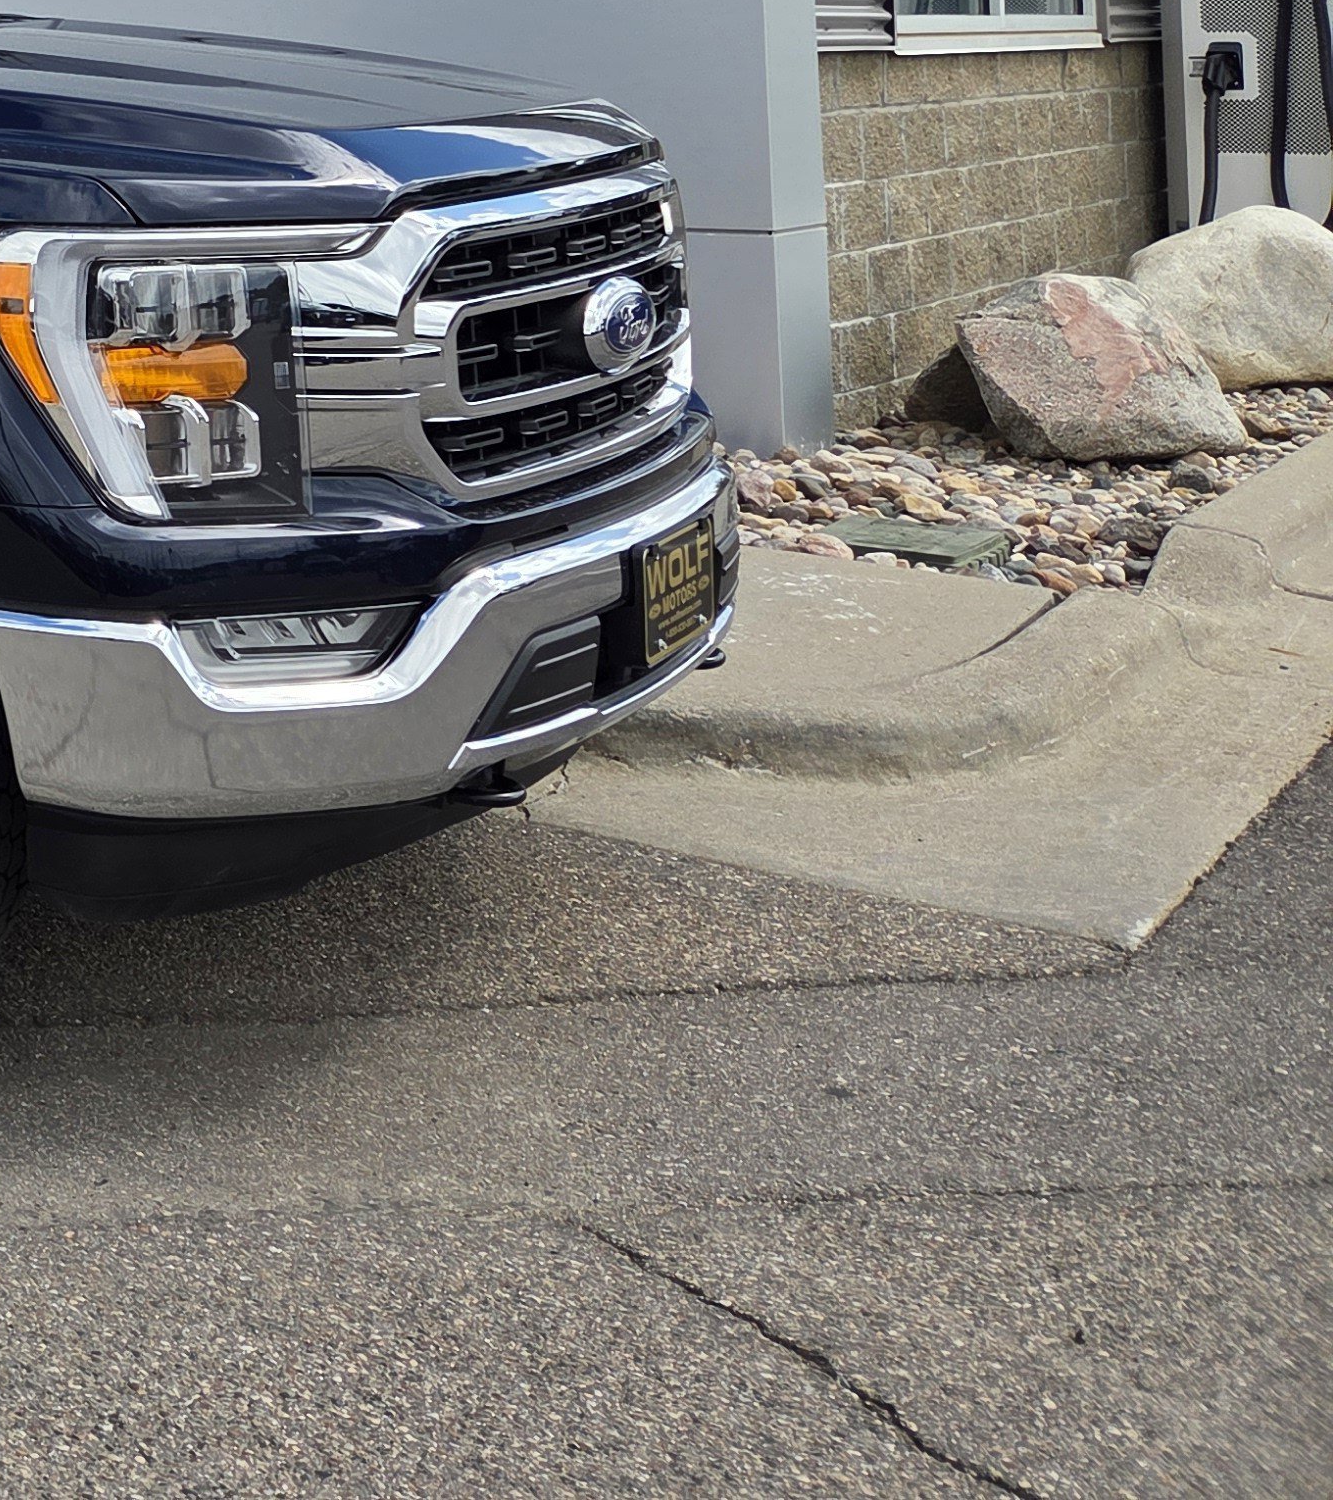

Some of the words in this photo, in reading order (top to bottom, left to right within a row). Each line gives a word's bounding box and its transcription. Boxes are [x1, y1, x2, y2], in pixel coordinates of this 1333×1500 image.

[618, 303, 650, 346] Ford
[646, 532, 710, 601] WOLF
[661, 579, 698, 616] MOTORS
